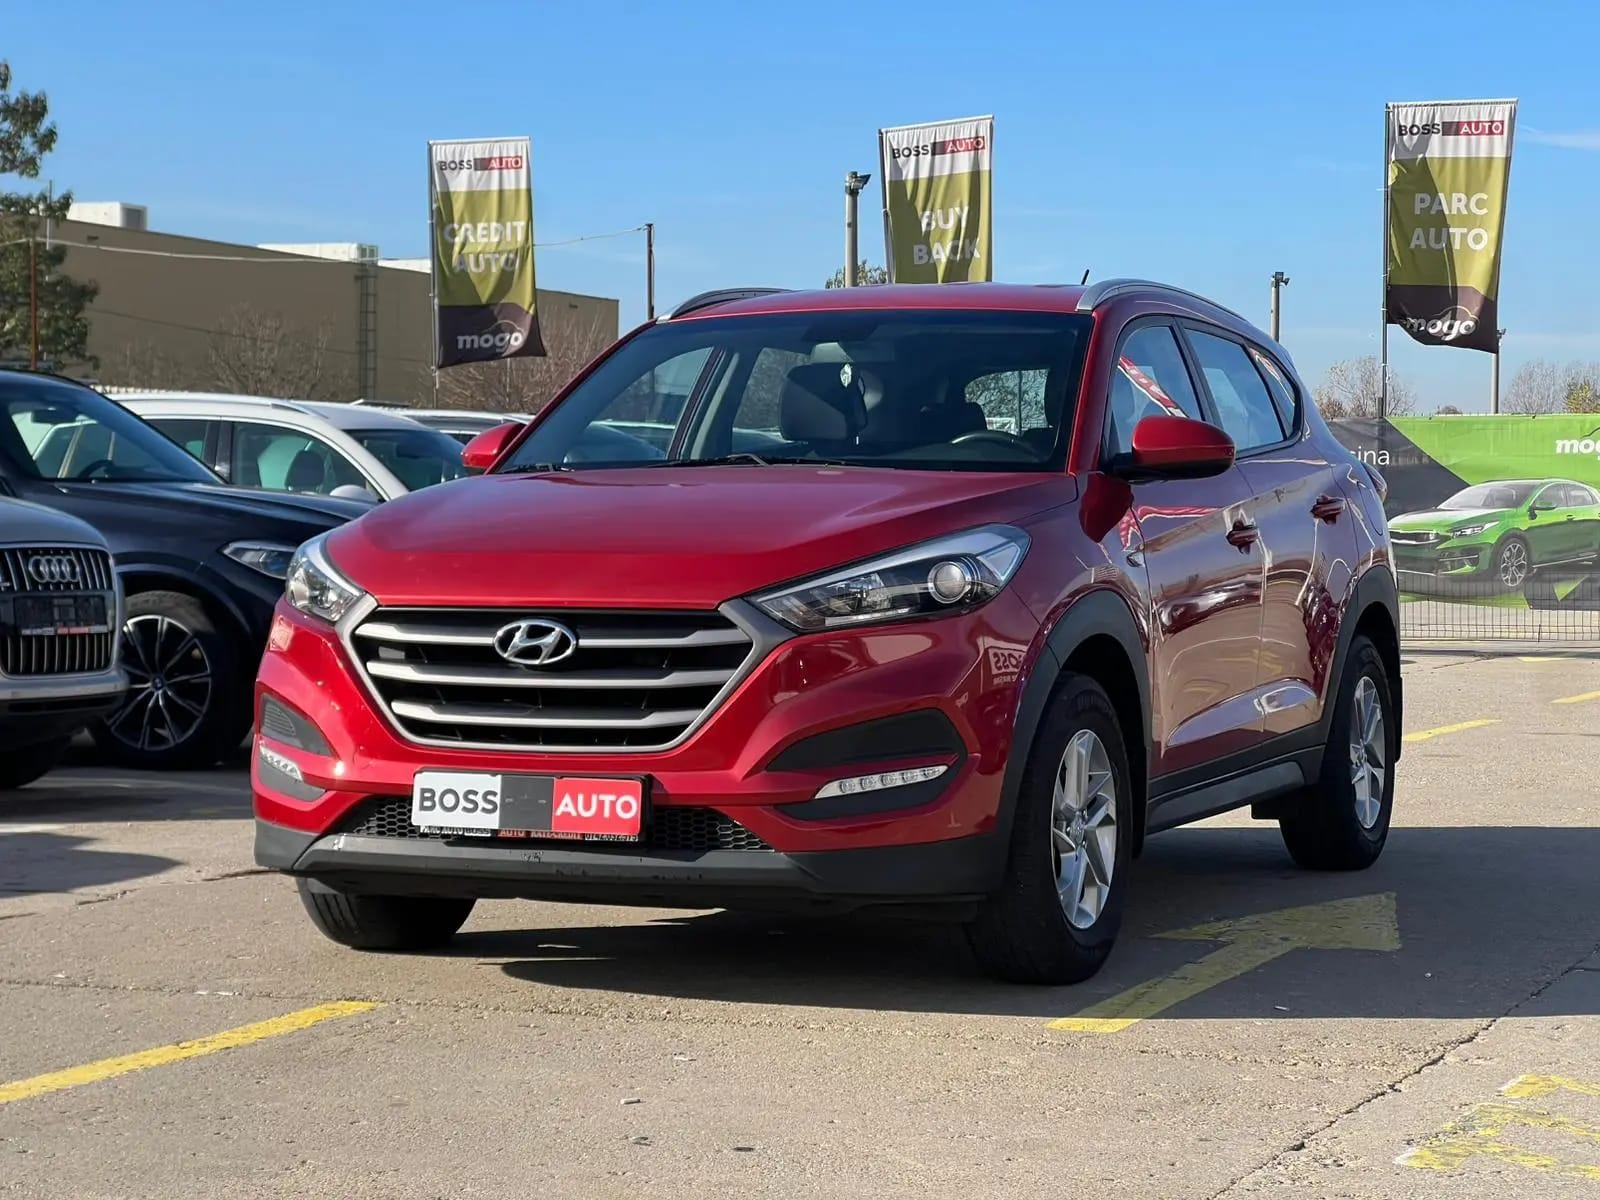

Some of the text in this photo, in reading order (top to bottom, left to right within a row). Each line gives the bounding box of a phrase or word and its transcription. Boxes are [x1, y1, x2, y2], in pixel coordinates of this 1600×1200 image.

[1399, 121, 1503, 137] BOSS AUTO
[892, 138, 984, 159] BOSS AUTO
[439, 156, 522, 171] BOSS AUTO
[1414, 192, 1489, 215] PARC
[443, 221, 526, 243] CREDIT
[1409, 227, 1489, 250] AUTO
[913, 238, 981, 265] BACK
[456, 253, 518, 273] AUTO
[1409, 316, 1477, 341] mogo
[456, 331, 524, 353] mogo
[1555, 439, 1600, 461] mo
[418, 787, 638, 819] BOSS AUTO
